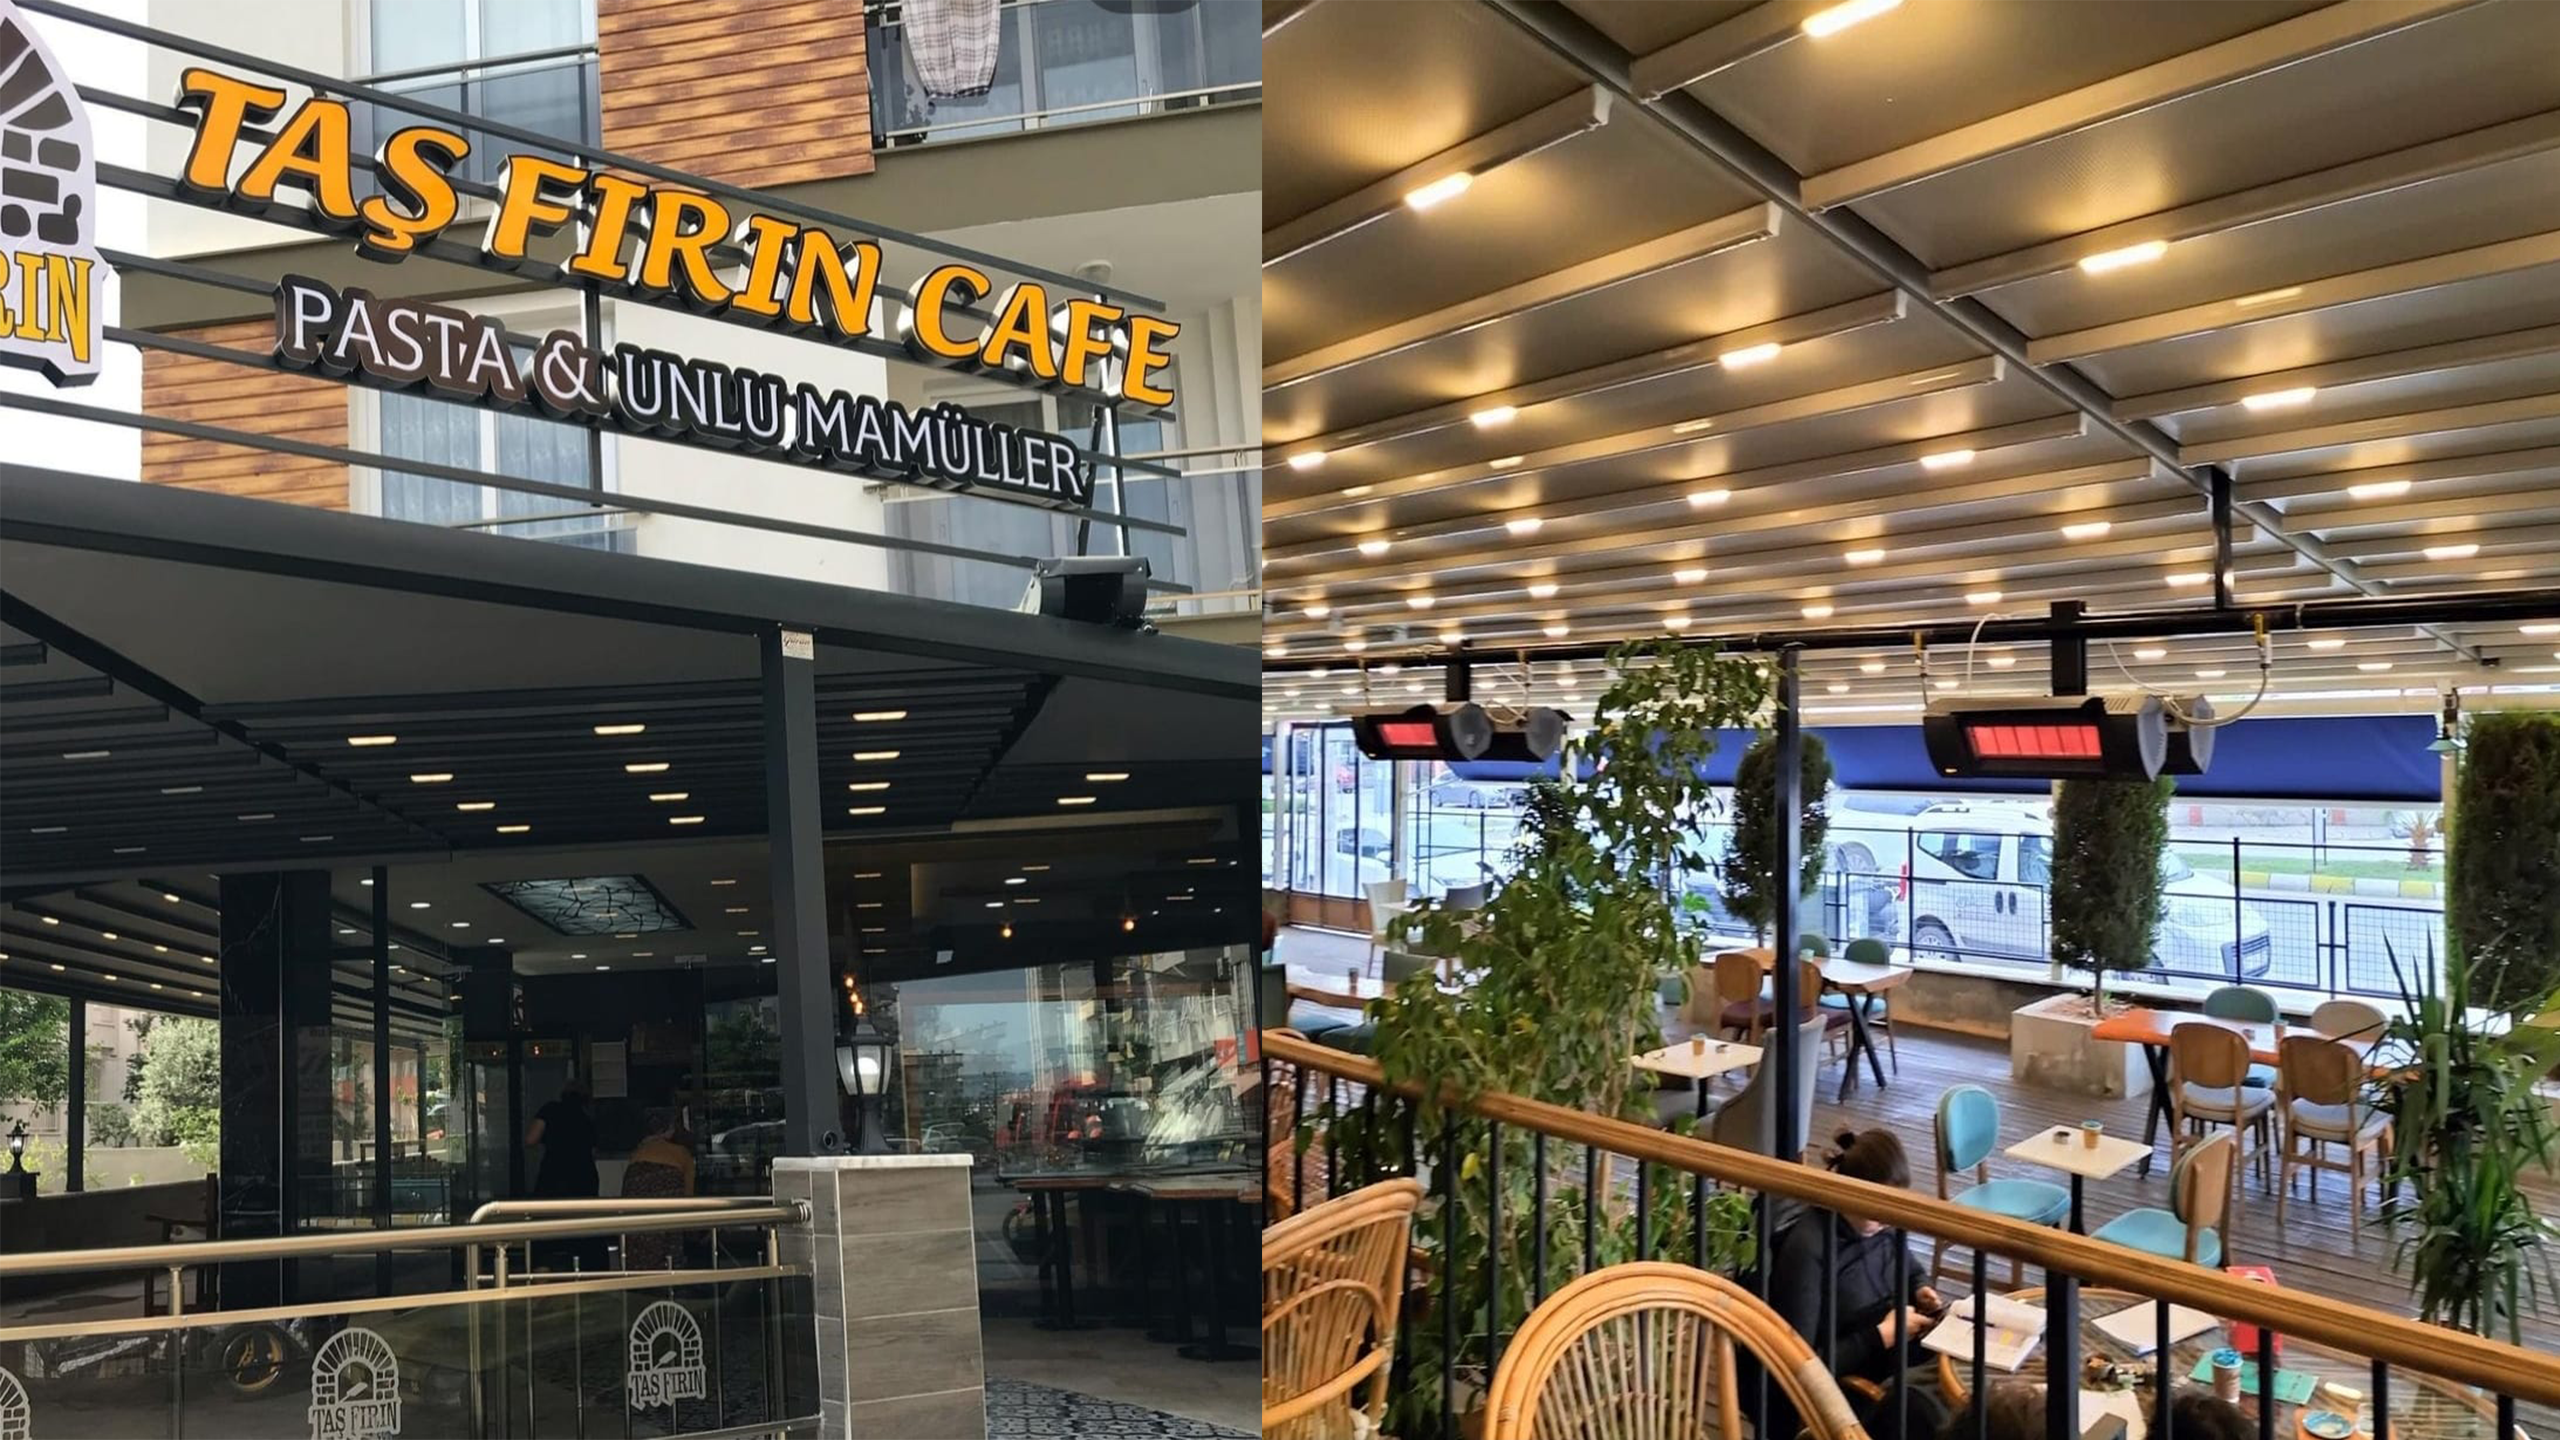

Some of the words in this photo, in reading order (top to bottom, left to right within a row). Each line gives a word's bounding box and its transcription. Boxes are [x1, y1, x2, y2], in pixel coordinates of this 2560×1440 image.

[184, 67, 471, 252] TAŞ
[491, 154, 883, 337] FIRIN
[912, 264, 1181, 406] CAFE
[292, 285, 515, 391] PASTA
[542, 338, 599, 403] &
[624, 352, 781, 438] UNLU
[804, 390, 1083, 496] MAMÜLLER
[313, 1407, 345, 1438] TAŞ
[351, 1401, 397, 1436] FIRIN
[631, 1374, 660, 1404] TAŞ
[663, 1368, 702, 1399] FIRIN
